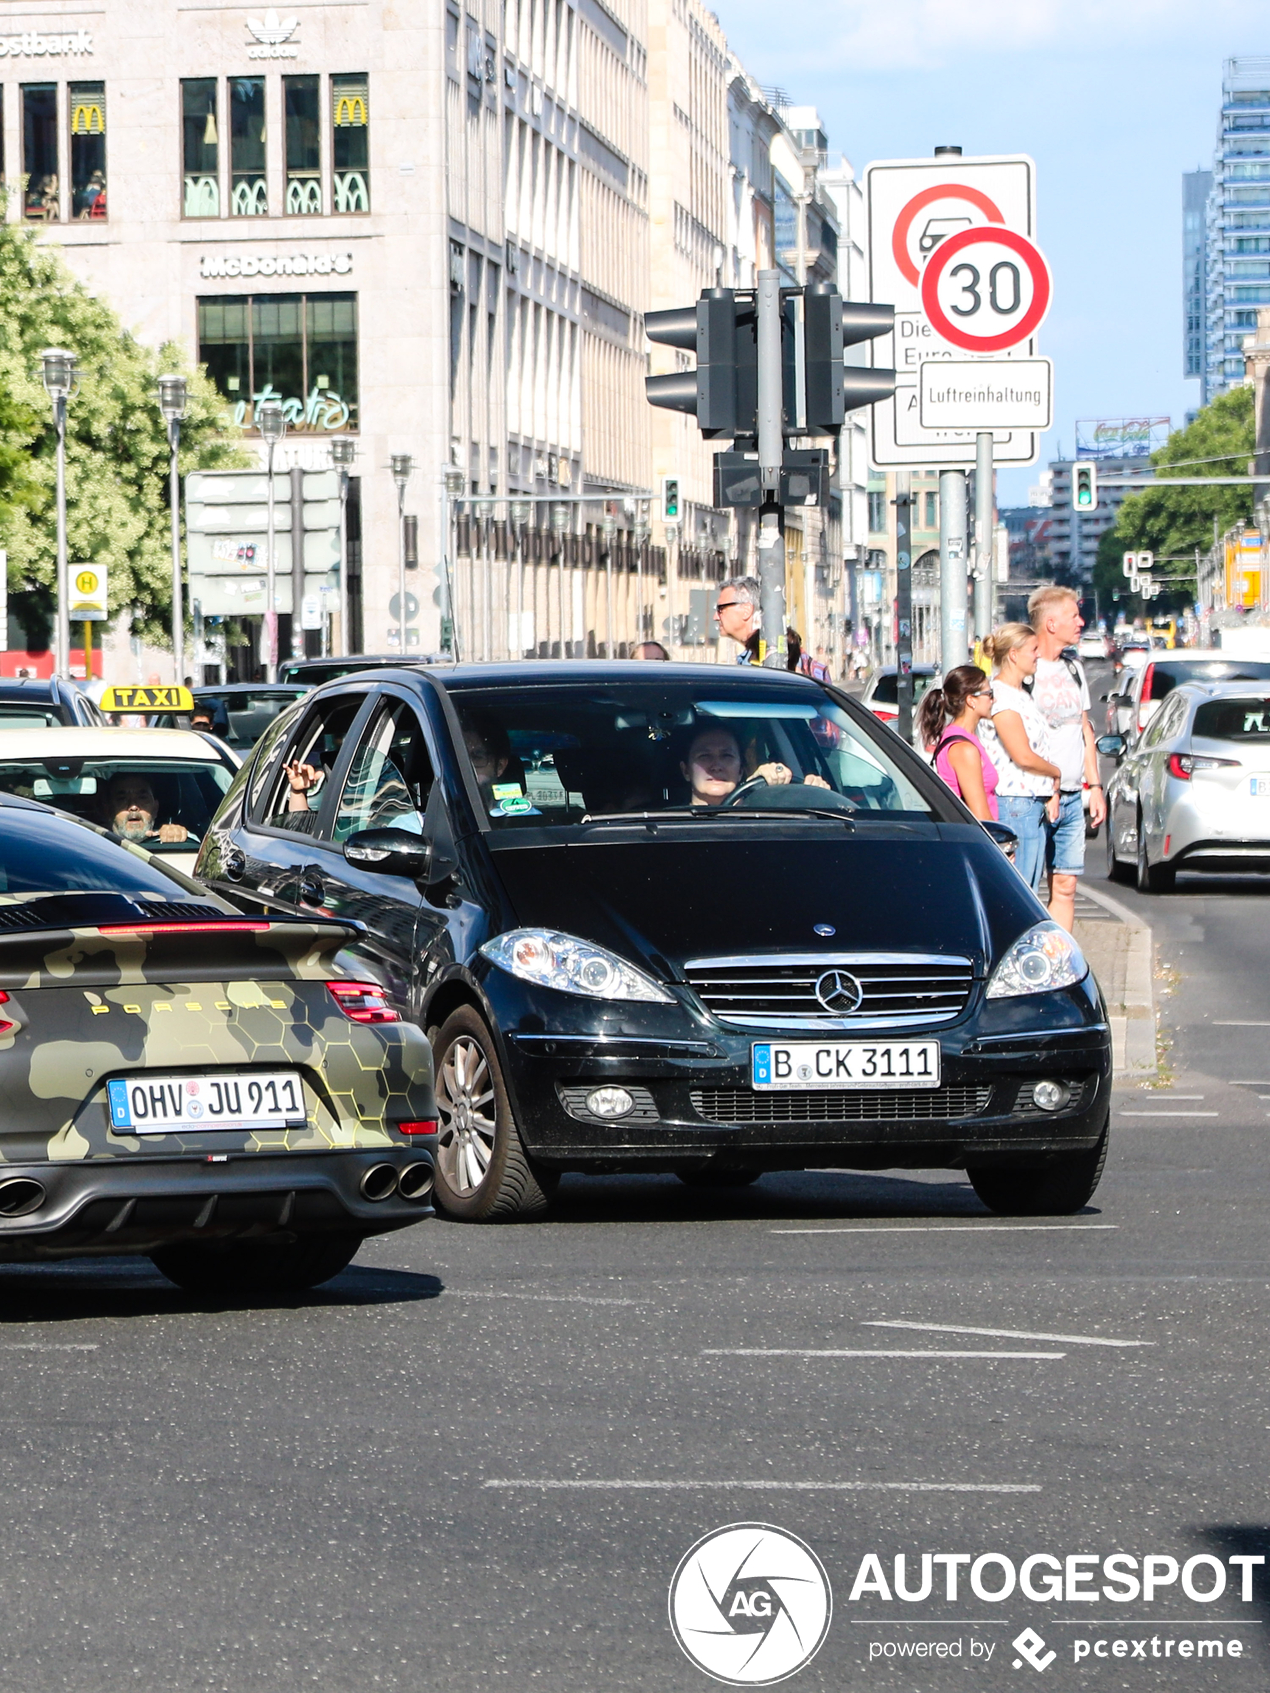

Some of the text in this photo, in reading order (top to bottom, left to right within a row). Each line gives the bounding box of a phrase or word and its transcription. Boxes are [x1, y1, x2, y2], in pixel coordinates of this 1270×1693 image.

[247, 45, 298, 59] adidas
[202, 253, 352, 278] McDonald's
[950, 261, 1021, 316] 30
[929, 386, 1041, 407] Luftreinhaltung
[82, 576, 93, 591] H
[115, 689, 178, 706] TAXI
[91, 999, 288, 1016] PORSCHE
[774, 1048, 932, 1078] B CK 3111
[132, 1080, 300, 1119] OHV JU 911
